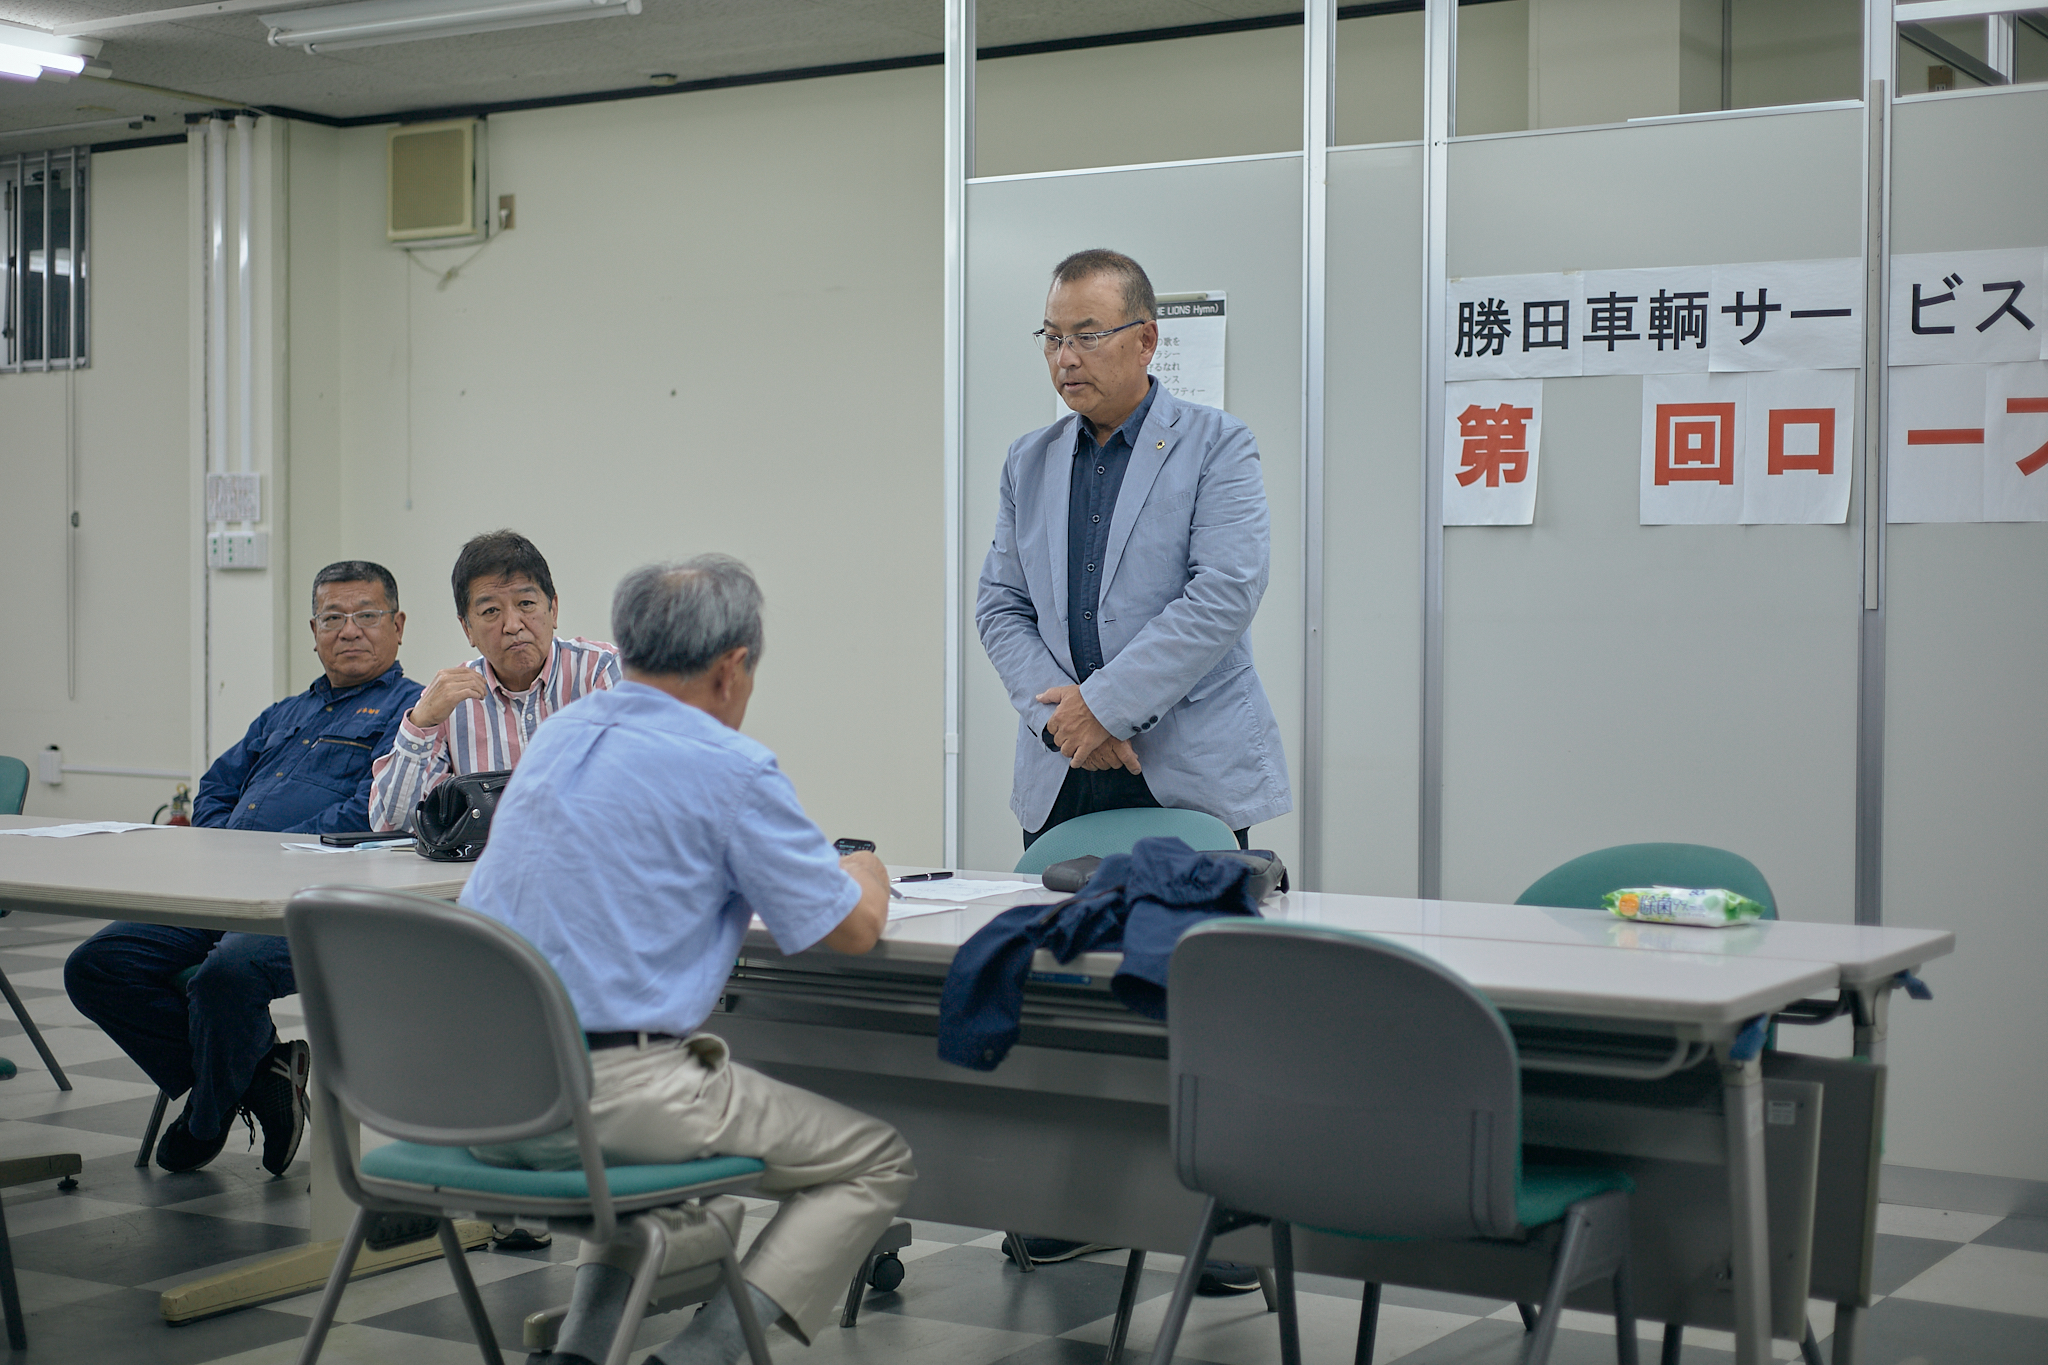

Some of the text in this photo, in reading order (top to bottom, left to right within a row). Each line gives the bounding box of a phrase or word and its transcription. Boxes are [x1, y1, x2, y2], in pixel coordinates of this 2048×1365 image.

[1167, 305, 1191, 316] LIONS
[1158, 375, 1180, 384] ンス
[1167, 387, 1205, 396] フティー
[1456, 403, 1533, 489] 第
